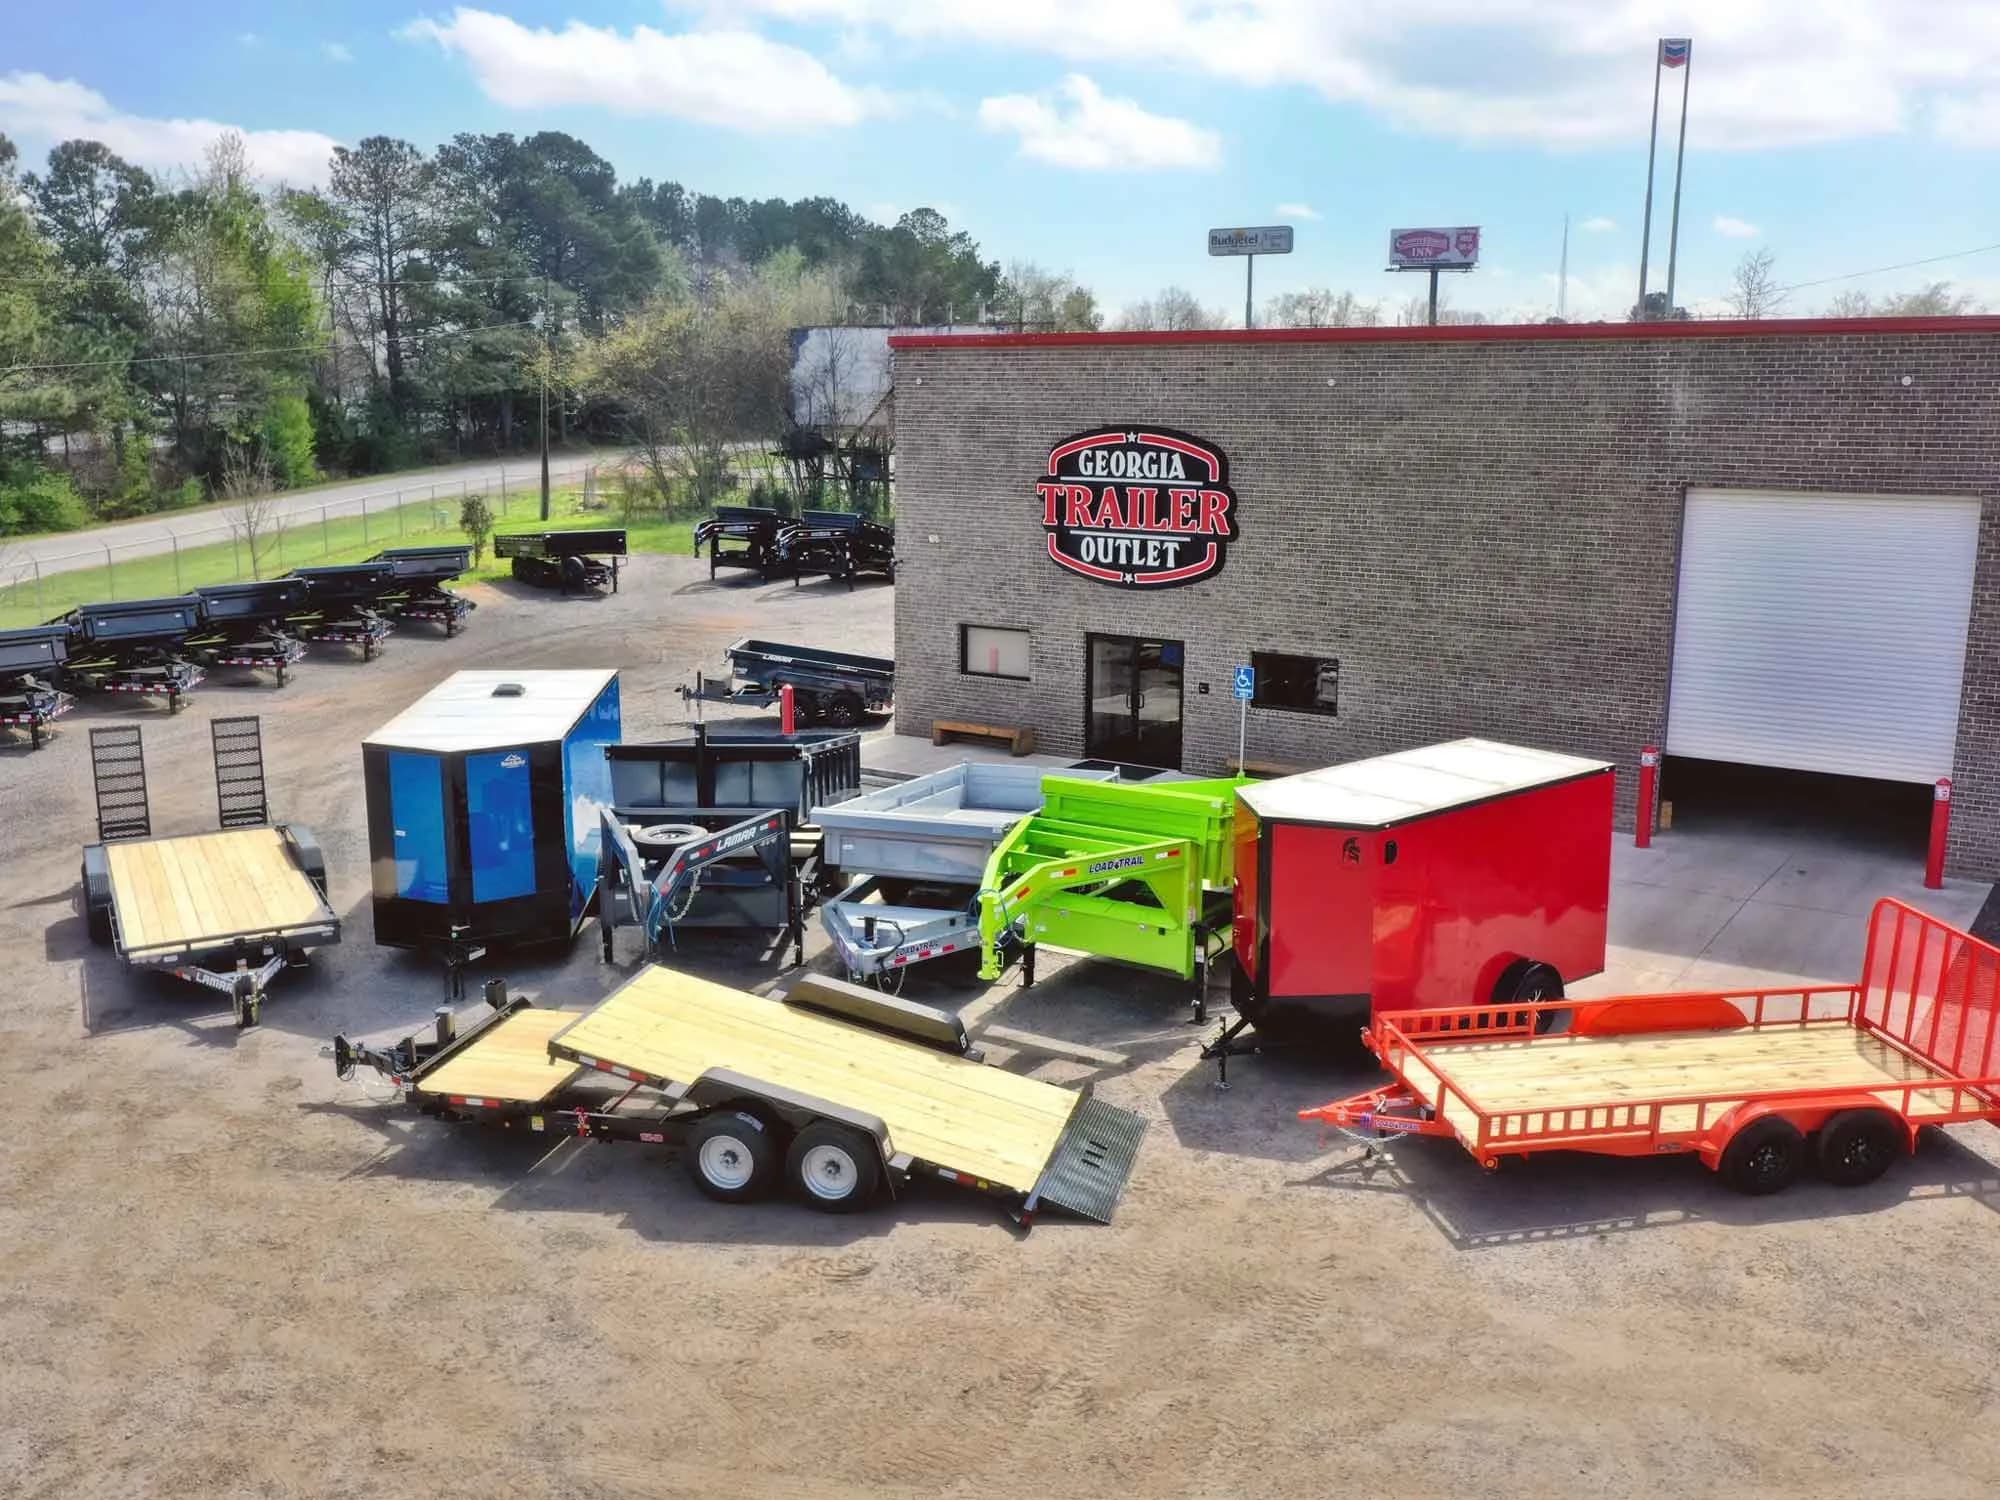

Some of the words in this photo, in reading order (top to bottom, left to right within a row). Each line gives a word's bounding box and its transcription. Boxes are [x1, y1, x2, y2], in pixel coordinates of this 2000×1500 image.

[1411, 246, 1433, 257] INN
[1078, 449, 1186, 479] GEORGIA
[1036, 483, 1230, 535] TRAILER
[1080, 536, 1181, 568] OUTLET
[716, 826, 757, 852] LAMAR
[1089, 861, 1115, 873] LOAD
[1118, 856, 1145, 867] TRAIL
[196, 972, 234, 994] LAMAR
